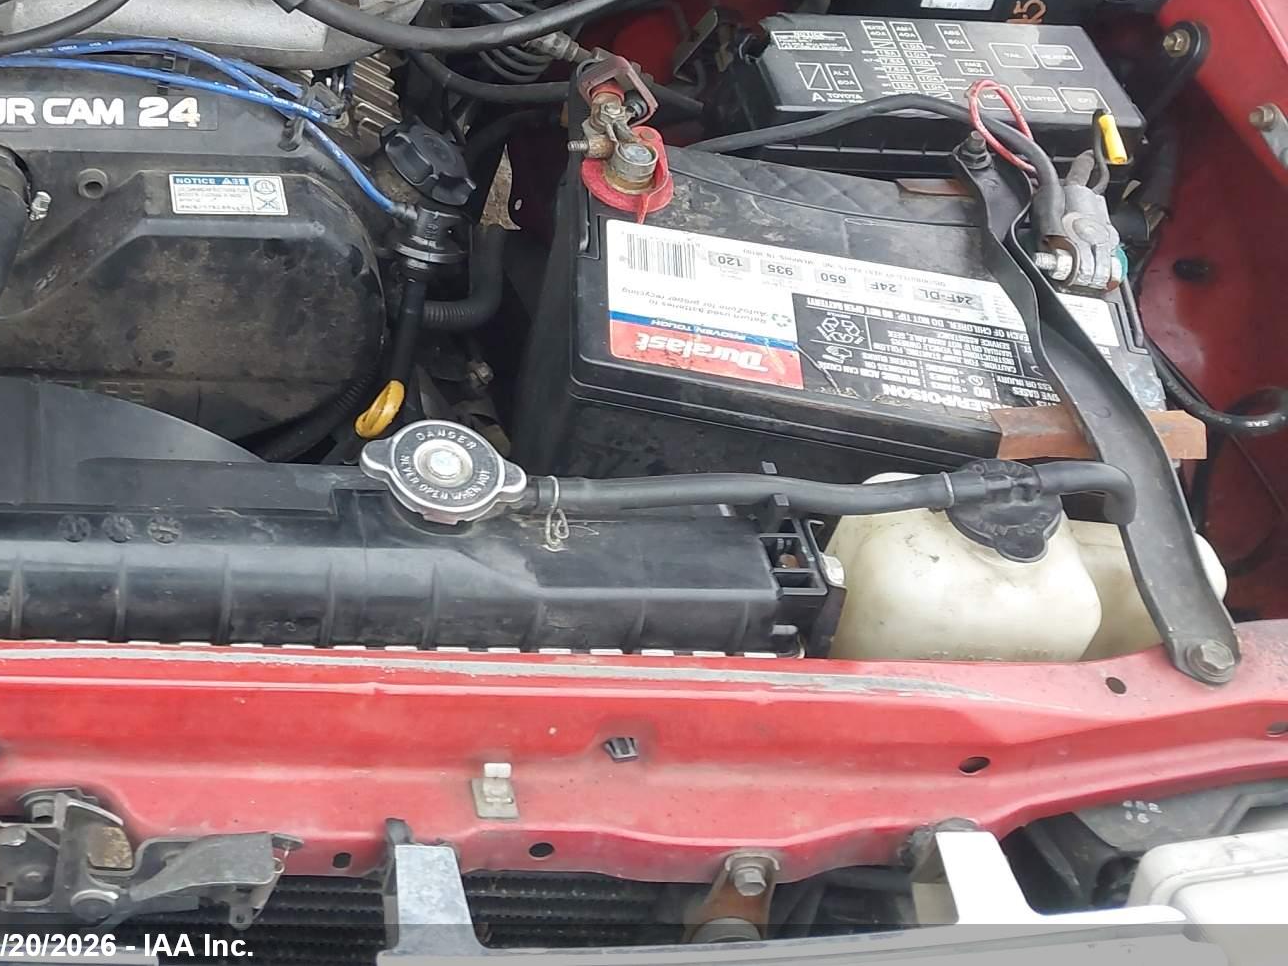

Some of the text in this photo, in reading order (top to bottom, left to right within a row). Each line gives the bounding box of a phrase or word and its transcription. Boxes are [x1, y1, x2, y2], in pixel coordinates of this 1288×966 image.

[812, 92, 826, 102] A
[826, 92, 864, 100] TOYOTA
[41, 96, 125, 126] CAM
[138, 96, 201, 128] 24
[175, 177, 216, 185] NOTICE
[718, 255, 744, 267] 120
[767, 263, 794, 276] 935
[820, 272, 847, 284] 650
[870, 282, 897, 293] 24F
[920, 288, 974, 306] 24F-DL
[932, 318, 944, 327] DO
[650, 319, 746, 340] PROVEN TOUGH
[993, 328, 1005, 337] OF
[635, 333, 769, 372] Duralast
[997, 374, 1025, 387] INJURY
[974, 387, 992, 399] NO
[415, 428, 478, 450] DANGER
